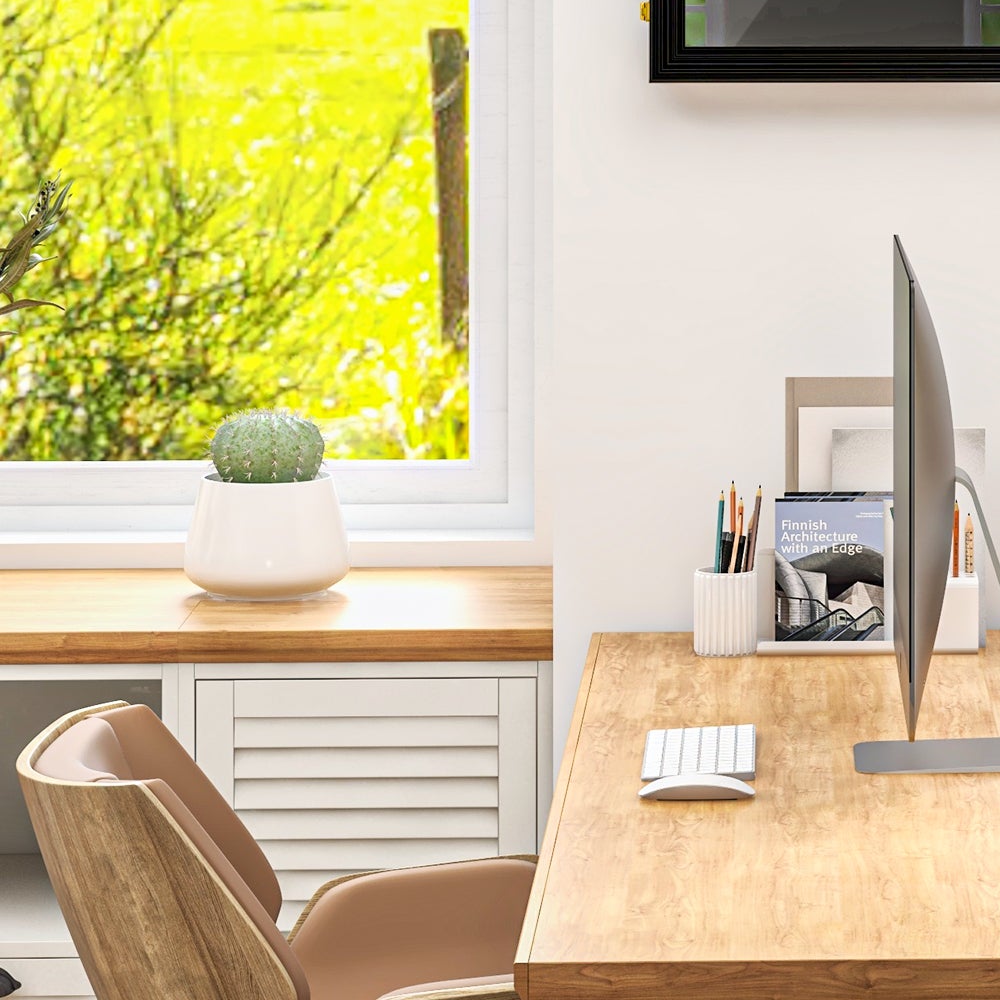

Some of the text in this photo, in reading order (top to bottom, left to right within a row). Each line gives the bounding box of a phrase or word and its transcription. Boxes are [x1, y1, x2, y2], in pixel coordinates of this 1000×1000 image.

[781, 519, 827, 530] Finnish
[781, 531, 858, 542] Architecture
[781, 542, 863, 555] with an Edge
